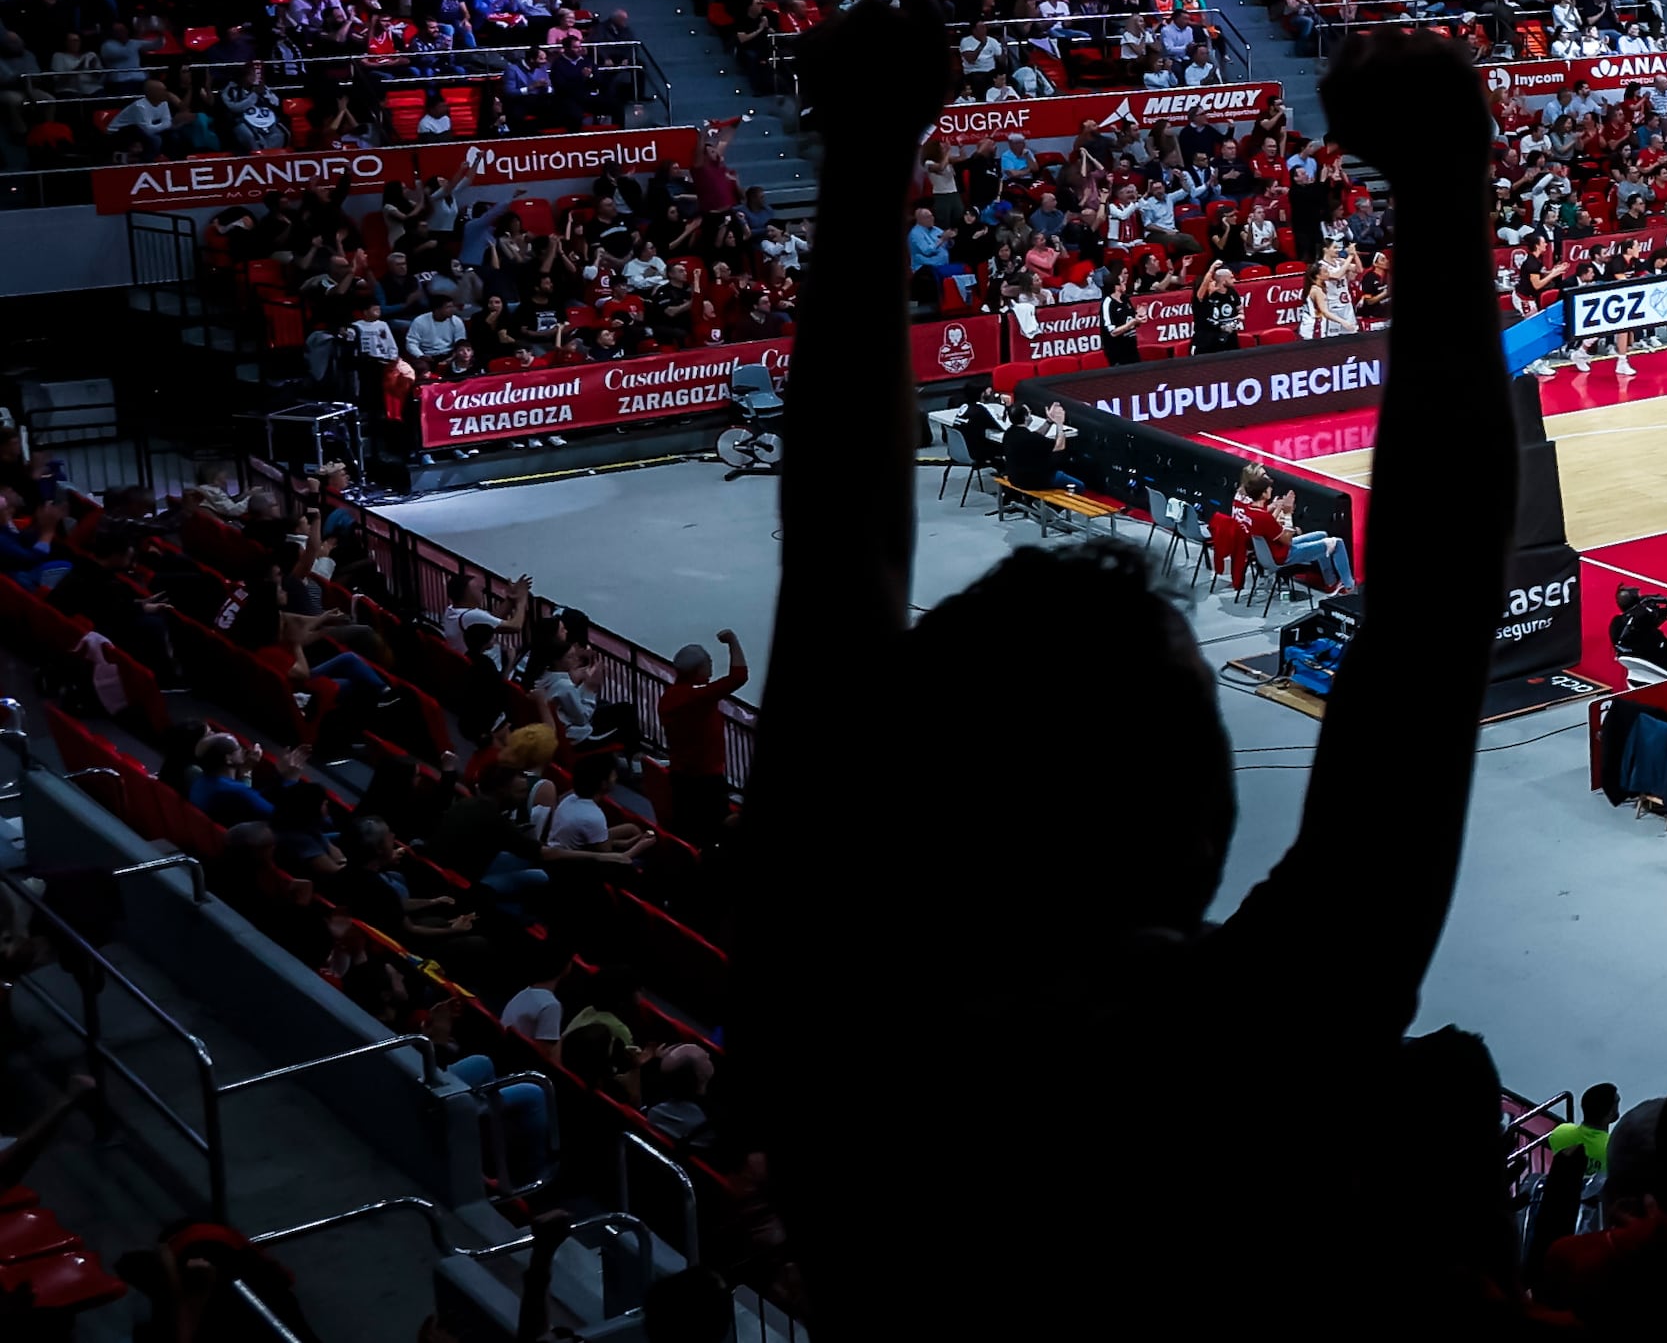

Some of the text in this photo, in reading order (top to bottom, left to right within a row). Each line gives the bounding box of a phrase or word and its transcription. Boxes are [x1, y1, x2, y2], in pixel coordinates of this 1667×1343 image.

[1514, 72, 1565, 87] Inycom
[1143, 89, 1262, 116] MERCURY
[939, 108, 1031, 134] SUGRAF
[130, 154, 384, 196] ALEJANDRO
[495, 140, 658, 179] quirónsalud
[1582, 291, 1646, 328] ZGZ
[604, 356, 740, 391] Casademont
[1131, 382, 1262, 422] LÚPULO
[1269, 355, 1382, 403] RECIÉN
[435, 377, 581, 412] Casademont
[618, 382, 732, 415] ZARAGOZA
[449, 404, 573, 437] ZARAGOZA
[1502, 575, 1577, 618] aser
[1495, 617, 1553, 641] seguros
